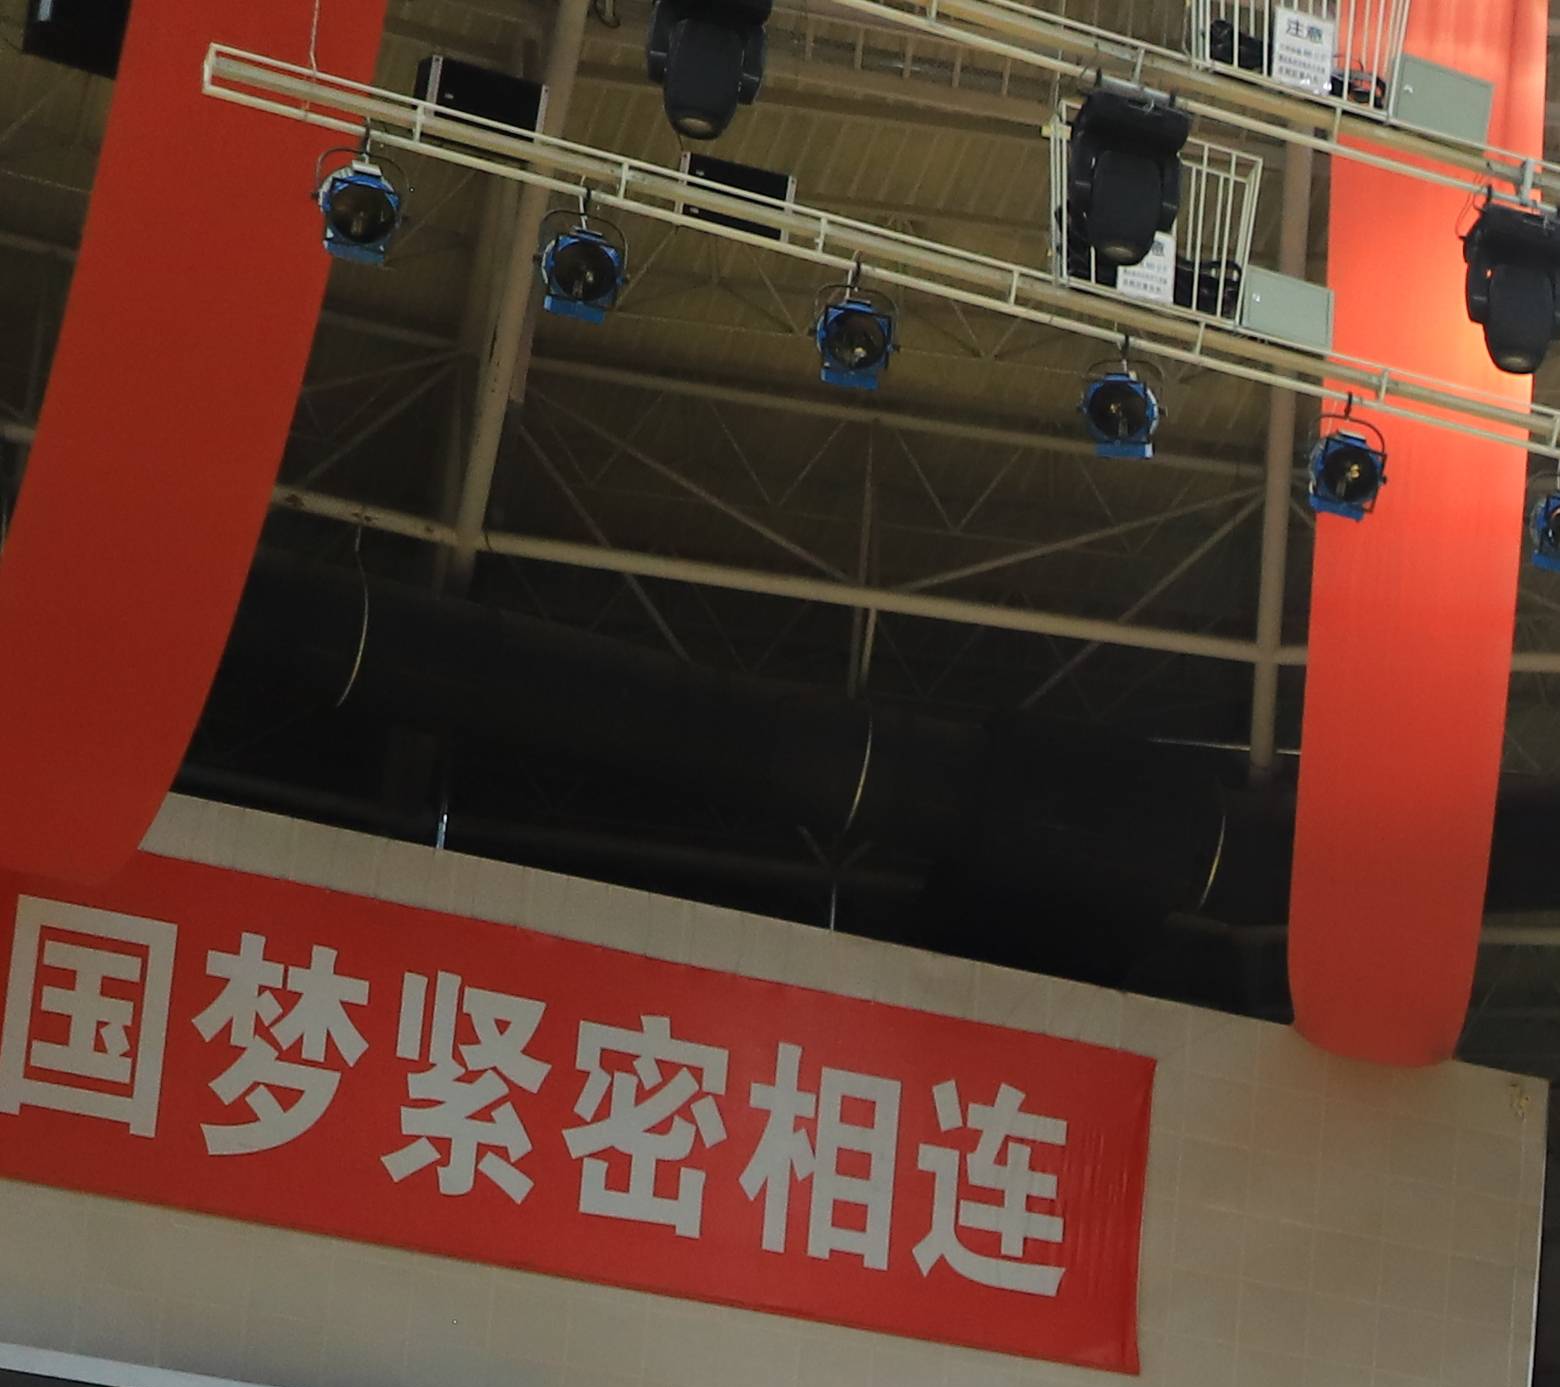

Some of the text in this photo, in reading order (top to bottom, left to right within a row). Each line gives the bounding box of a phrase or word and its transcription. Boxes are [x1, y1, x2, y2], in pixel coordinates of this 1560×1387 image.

[0, 893, 1071, 1297] 国梦紧密相连
